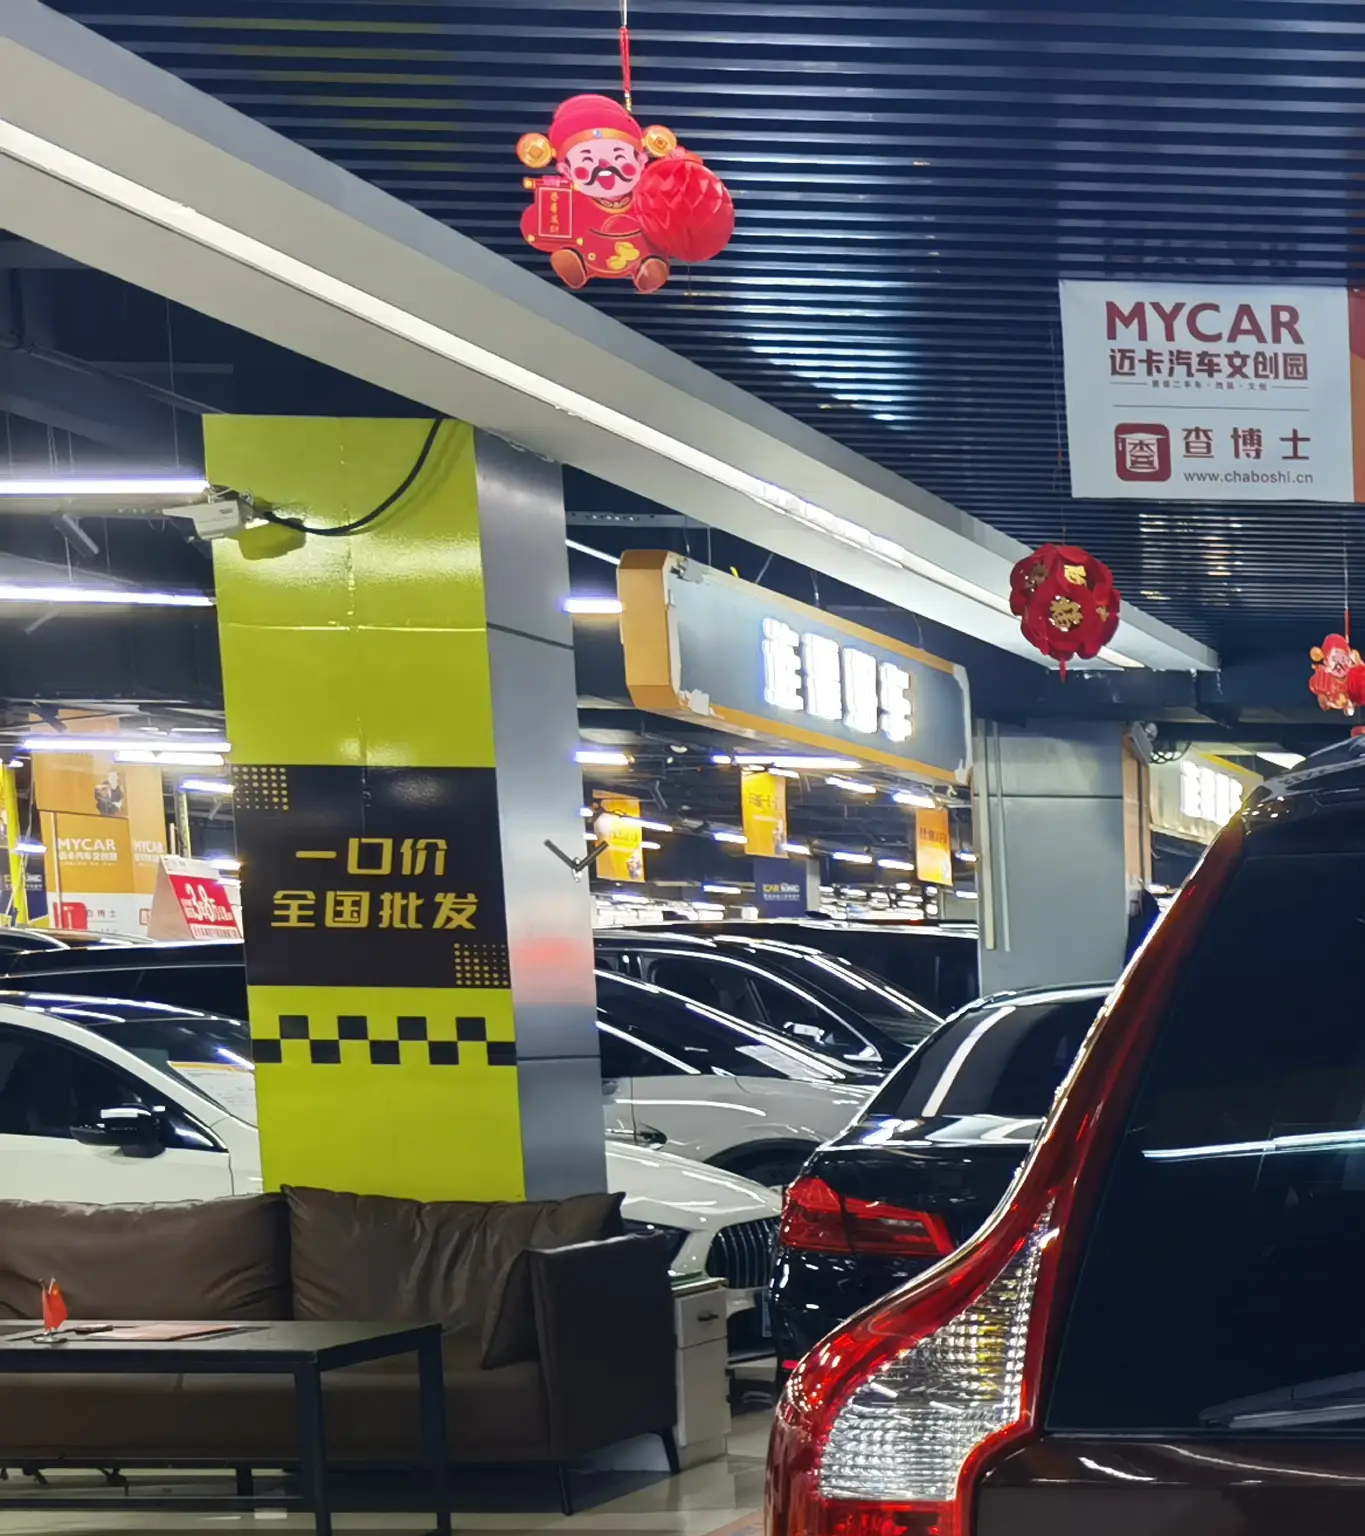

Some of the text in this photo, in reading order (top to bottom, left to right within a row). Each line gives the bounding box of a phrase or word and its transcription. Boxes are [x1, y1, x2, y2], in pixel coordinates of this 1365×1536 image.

[1105, 300, 1305, 345] MYCAR
[1109, 348, 1309, 381] 迈卡汽车文创园
[1181, 426, 1311, 460] 查博士
[1184, 470, 1314, 484] www.chaboshi.cn
[57, 838, 117, 851] MYCAR
[295, 836, 448, 877] 一口价
[272, 889, 478, 930] 全国批发
